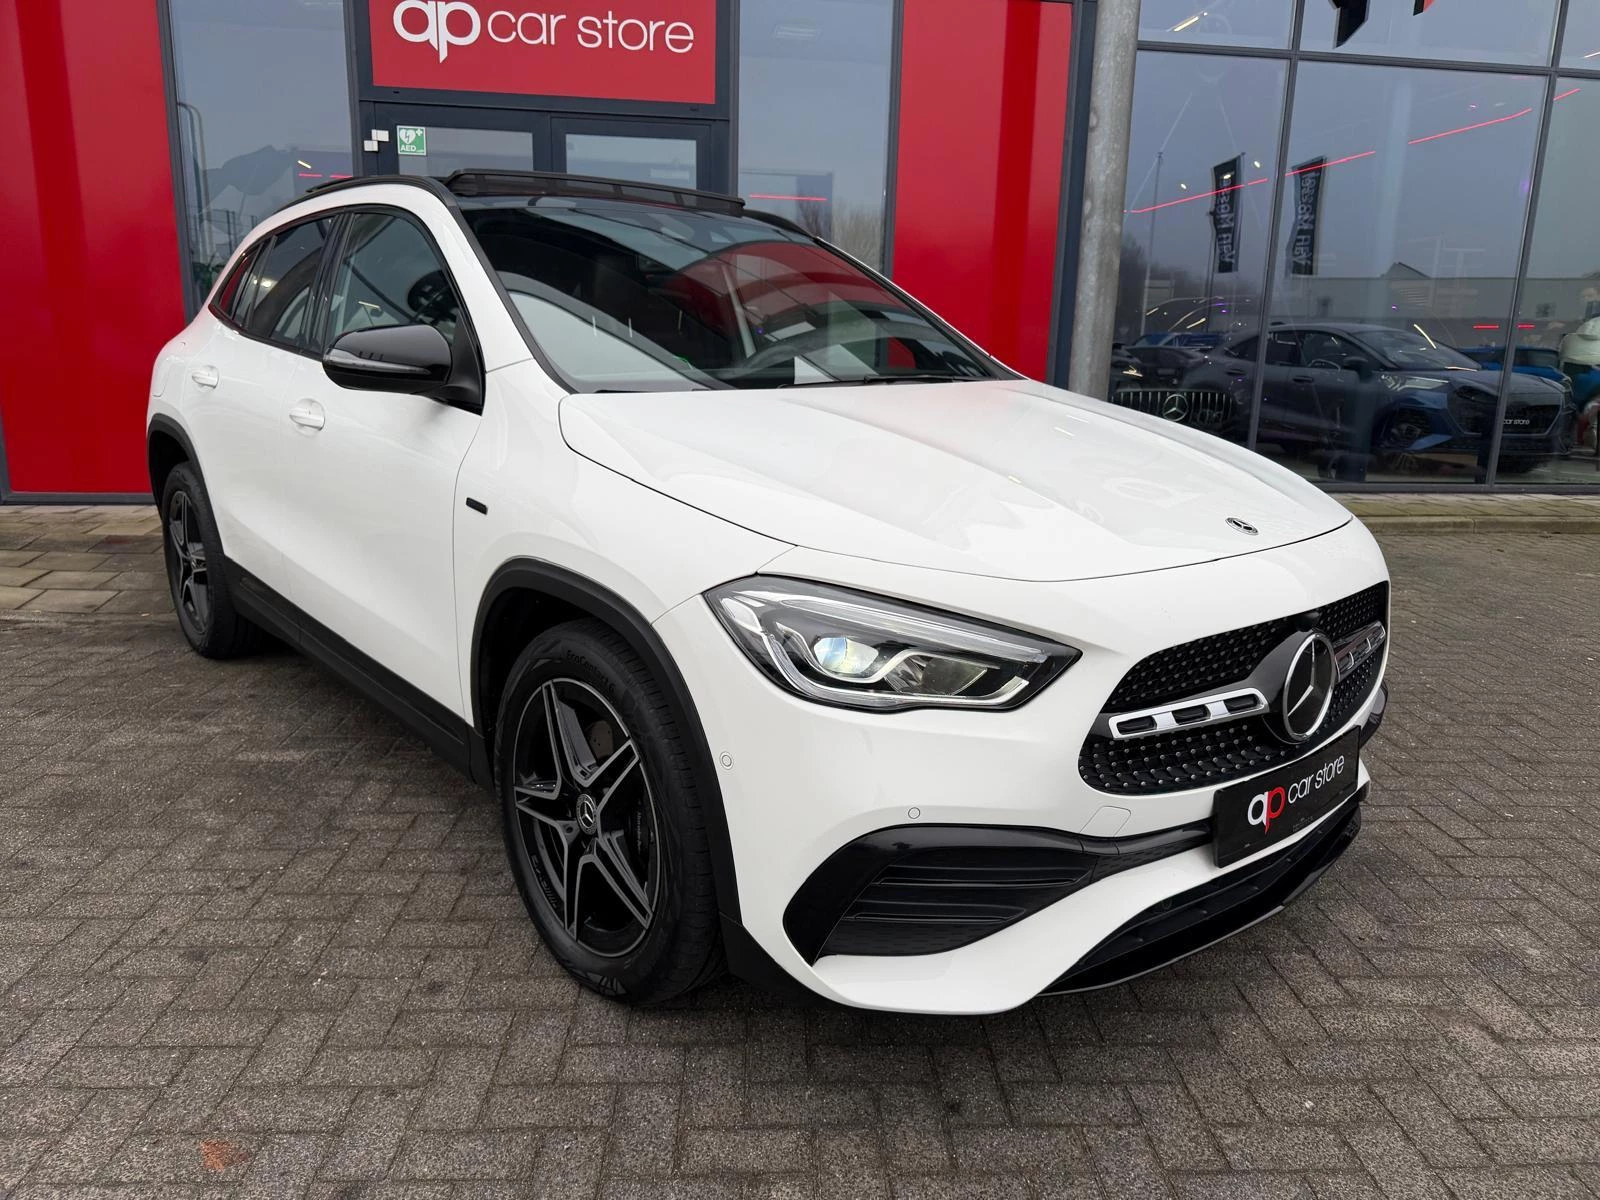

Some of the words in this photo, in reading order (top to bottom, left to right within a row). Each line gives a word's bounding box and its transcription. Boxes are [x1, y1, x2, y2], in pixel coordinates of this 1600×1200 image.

[487, 10, 566, 45] car
[576, 10, 694, 53] store
[400, 144, 417, 152] AED
[1247, 786, 1286, 834] ap
[1287, 773, 1315, 804] car
[1314, 755, 1345, 789] store
